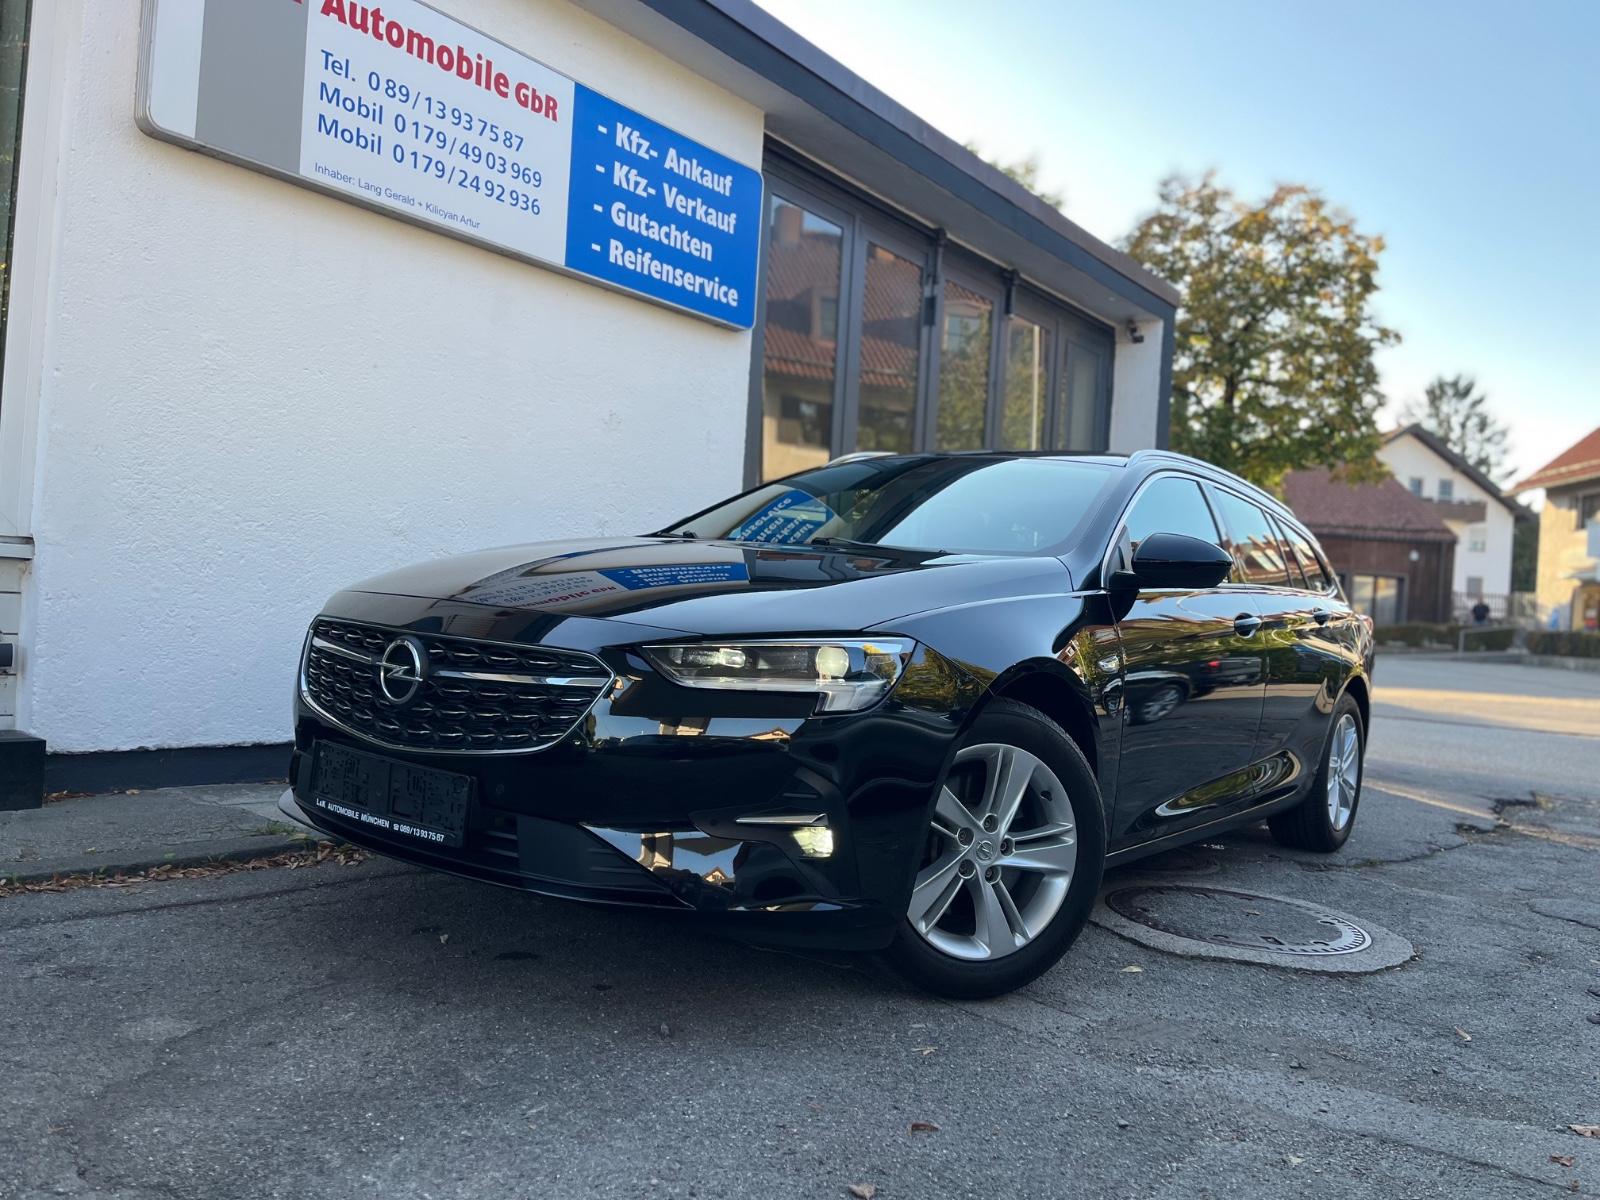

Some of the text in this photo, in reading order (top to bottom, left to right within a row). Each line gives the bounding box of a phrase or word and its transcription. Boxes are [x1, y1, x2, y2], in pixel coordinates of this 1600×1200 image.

[320, 0, 558, 122] Automobile GbR
[320, 49, 356, 82] Tel.
[319, 81, 383, 125] Mobil
[318, 113, 382, 155] Mobil
[615, 122, 658, 160] Kfz-
[664, 147, 733, 197] Ankauf
[314, 162, 356, 185] Inhaber:
[358, 177, 382, 196] Lang
[384, 187, 415, 206] Gerald
[613, 161, 656, 198] Kfz-
[662, 182, 737, 234] Verkauf
[610, 201, 713, 262] Gutachten
[609, 238, 739, 307] Reifenservice
[327, 802, 359, 820] AUTOMOBILE
[360, 812, 390, 828] MÜNCHEN
